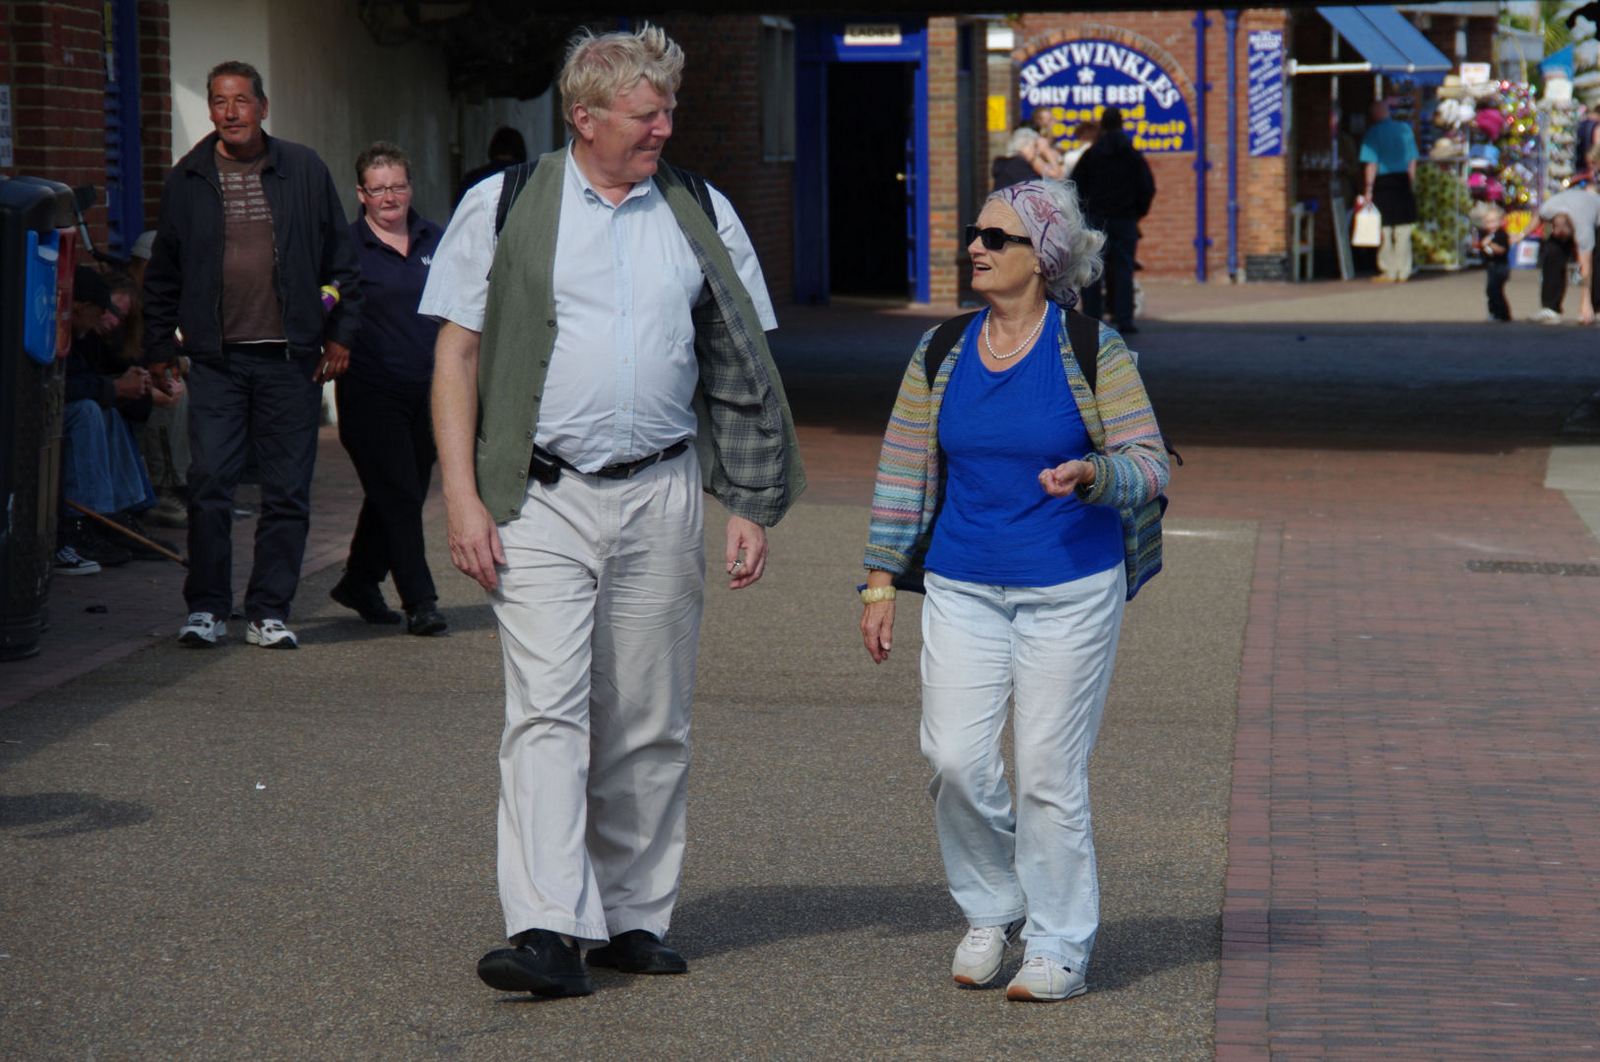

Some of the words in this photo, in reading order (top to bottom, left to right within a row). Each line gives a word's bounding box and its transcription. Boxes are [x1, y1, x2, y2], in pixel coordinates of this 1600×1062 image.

[1028, 86, 1070, 106] ONLY
[1072, 85, 1104, 105] THE
[1105, 84, 1146, 105] BEST
[1050, 104, 1146, 122] Seafod
[1136, 120, 1187, 135] Fruit
